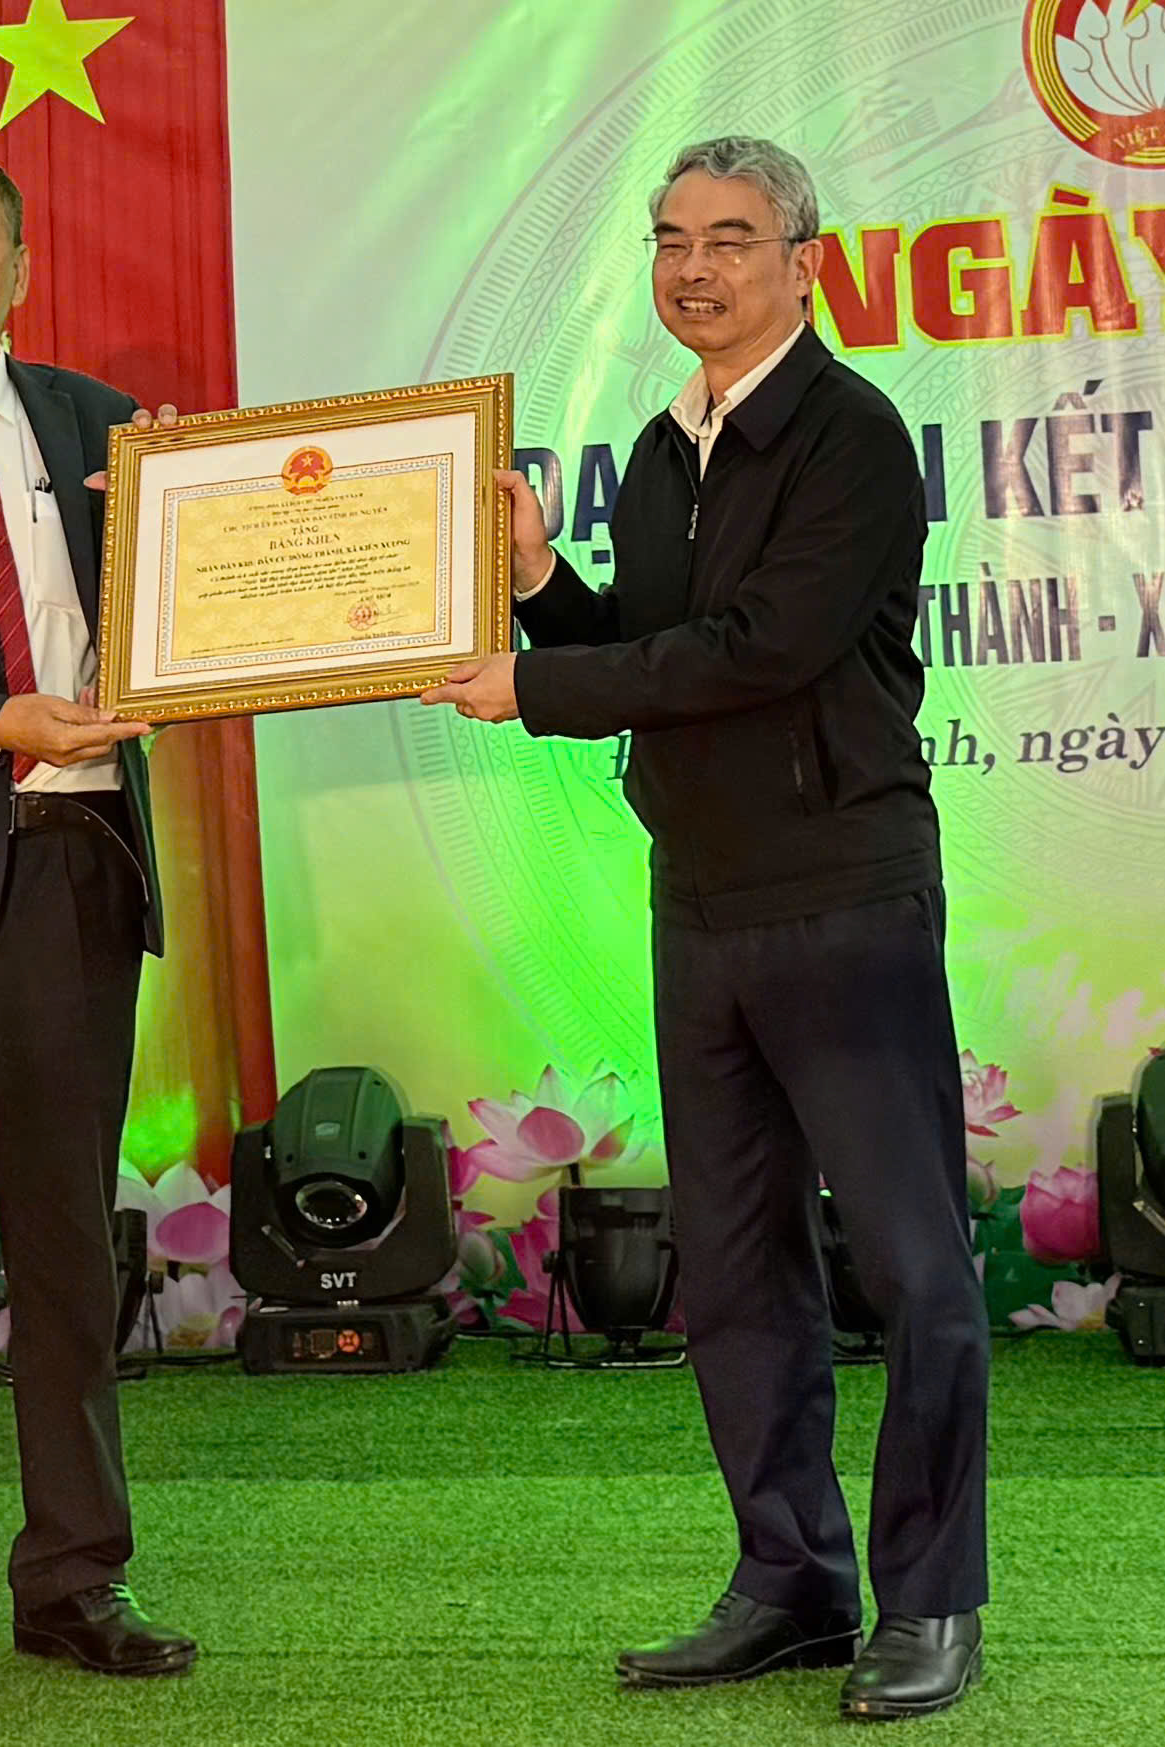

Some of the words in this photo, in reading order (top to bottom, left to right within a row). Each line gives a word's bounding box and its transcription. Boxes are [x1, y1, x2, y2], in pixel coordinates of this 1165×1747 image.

[1114, 125, 1159, 149] VIỆT
[514, 443, 619, 564] ĐẠ
[980, 379, 1154, 519] KẾT
[918, 562, 1081, 667] THÀNH
[1017, 712, 1165, 773] ngày
[321, 1272, 357, 1289] SVT
